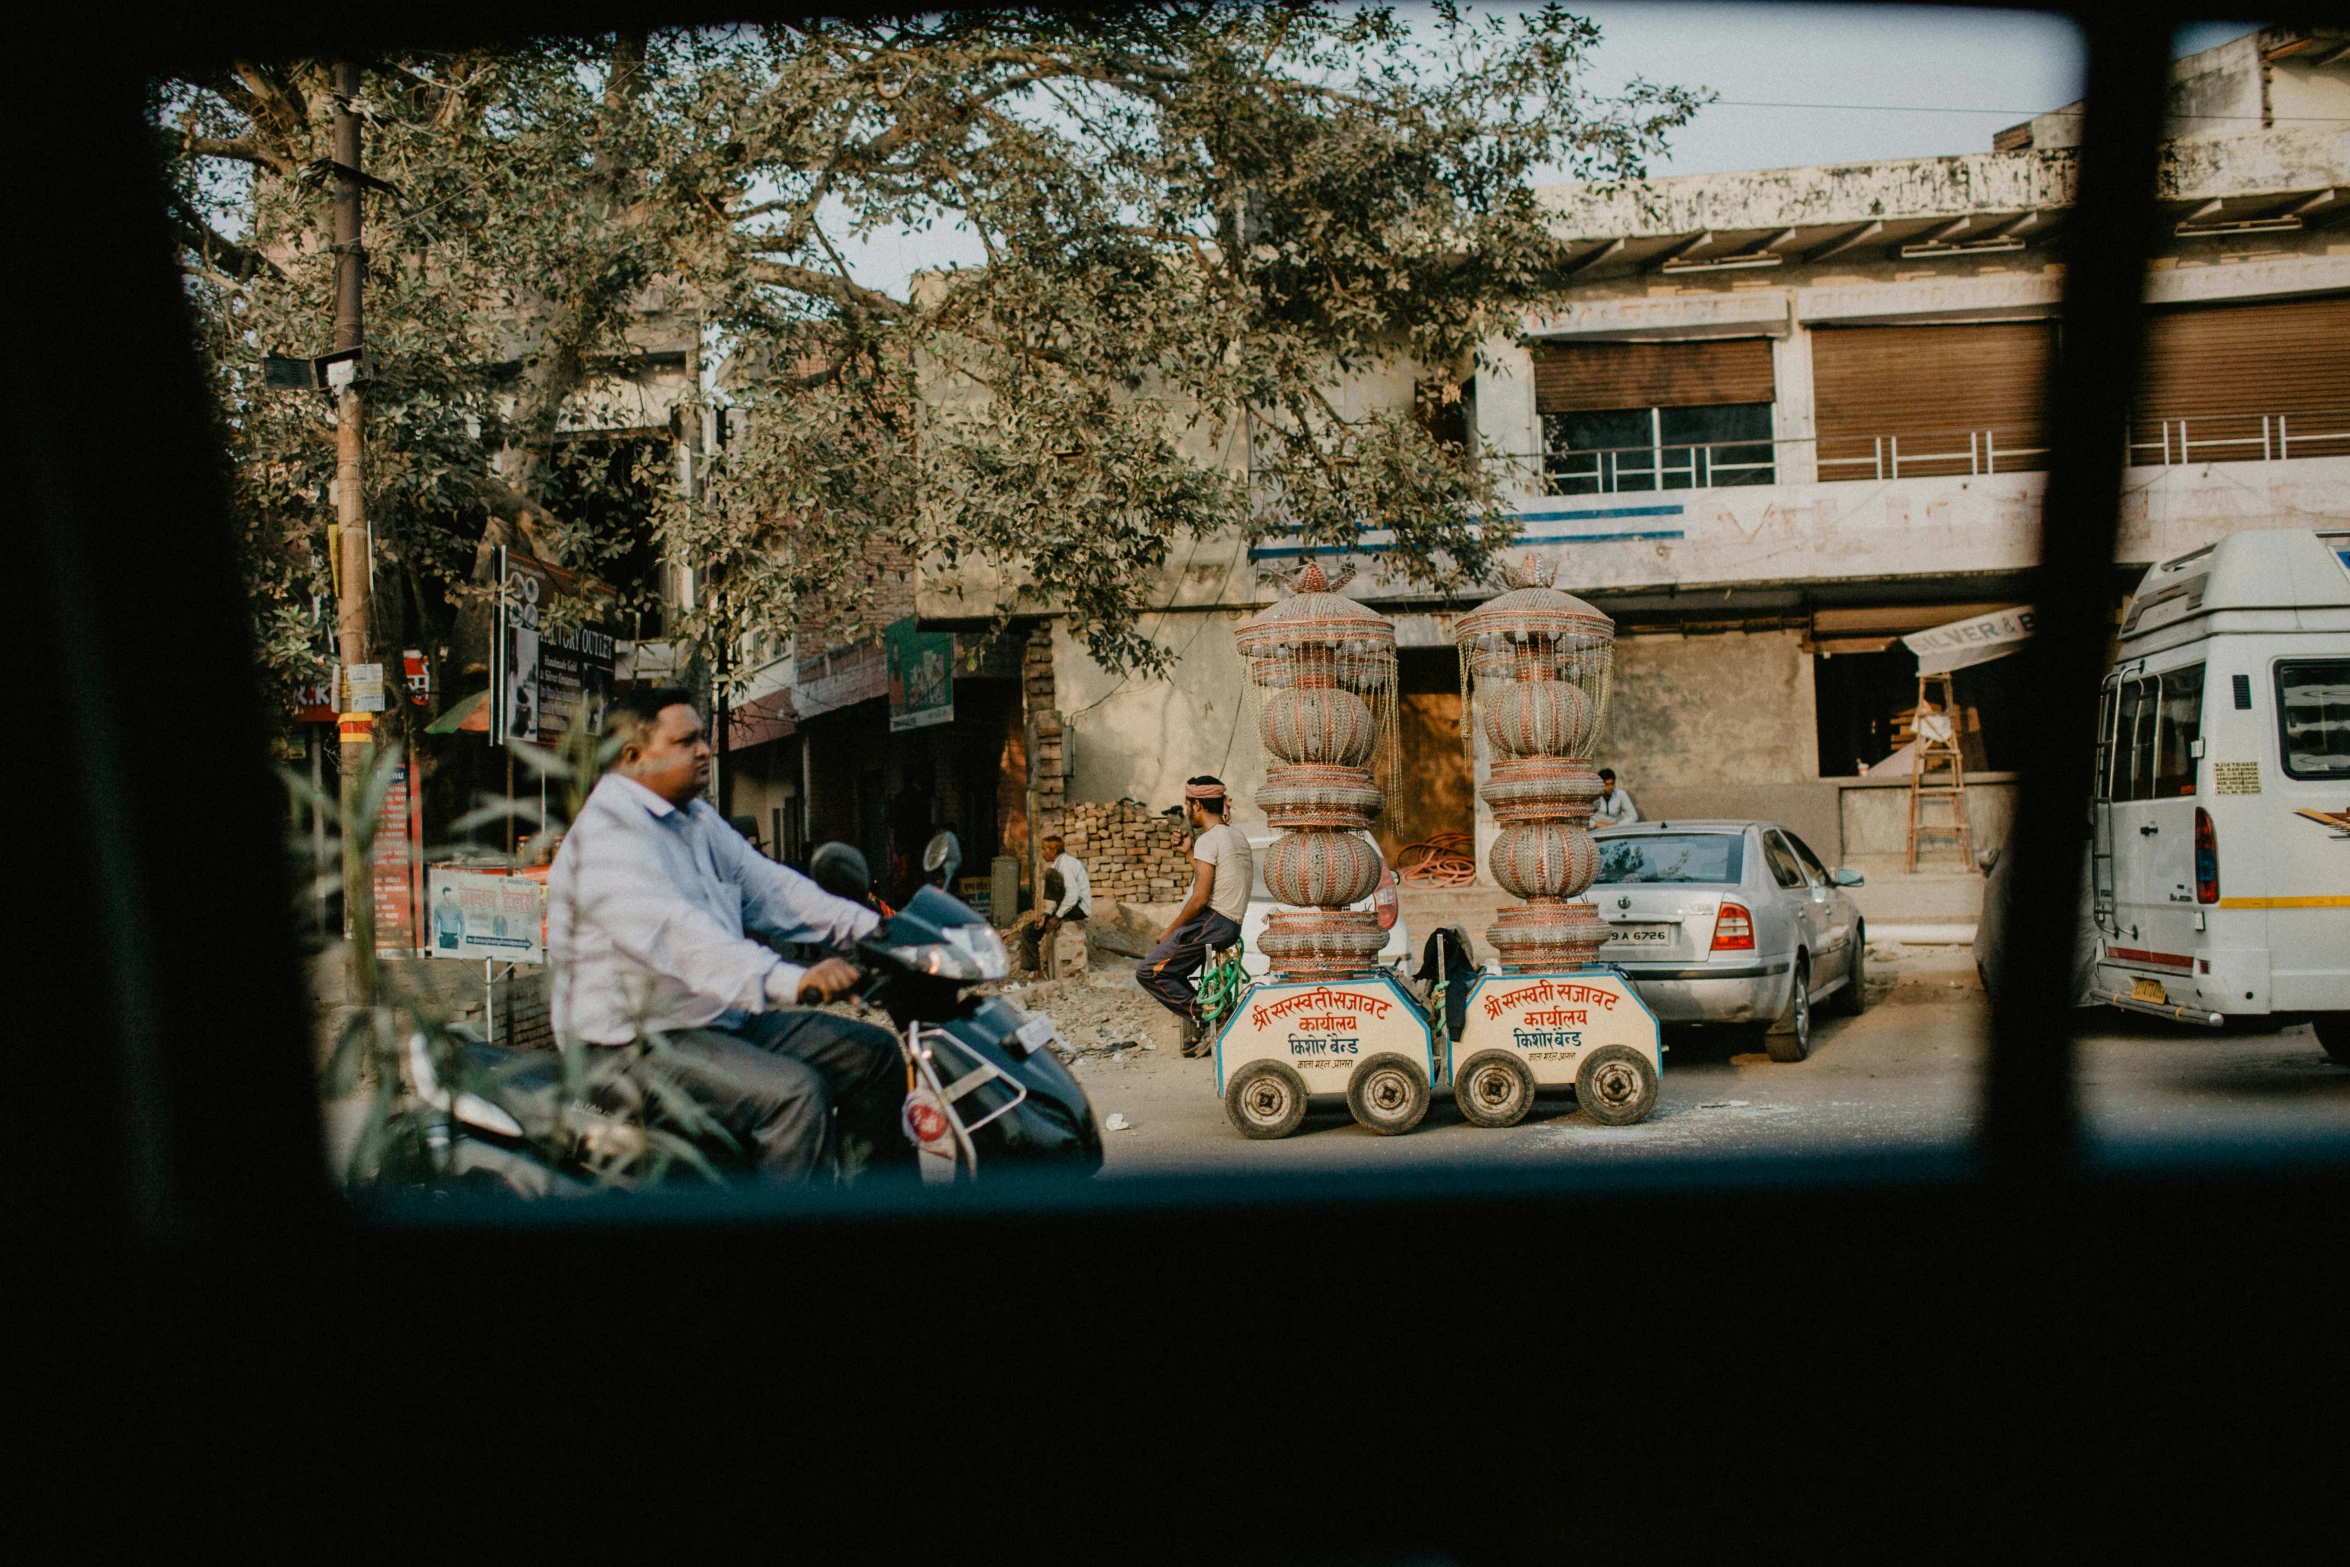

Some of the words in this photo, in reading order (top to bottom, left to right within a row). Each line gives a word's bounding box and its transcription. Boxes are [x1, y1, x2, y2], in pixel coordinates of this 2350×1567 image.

[2003, 616, 2017, 634] &
[582, 628, 614, 660] OUTLET
[1633, 931, 1666, 940] 6726
[1252, 1004, 1272, 1032] श्री
[1270, 986, 1333, 1019] सरस्वती
[1333, 991, 1392, 1020] सजावट
[1484, 995, 1503, 1021] श्री
[1501, 978, 1554, 1011] सरस्वती
[1556, 983, 1620, 1011] सजावट
[1298, 1012, 1358, 1034] कार्यालय
[1523, 1005, 1588, 1029] कार्यालय
[1288, 1032, 1327, 1056] किशोर
[1513, 1027, 1553, 1050] किशोर
[1297, 1060, 1313, 1069] काला
[1314, 1060, 1330, 1069] महल
[1332, 1060, 1354, 1069] आगरा
[1559, 1052, 1576, 1061] आगरा
